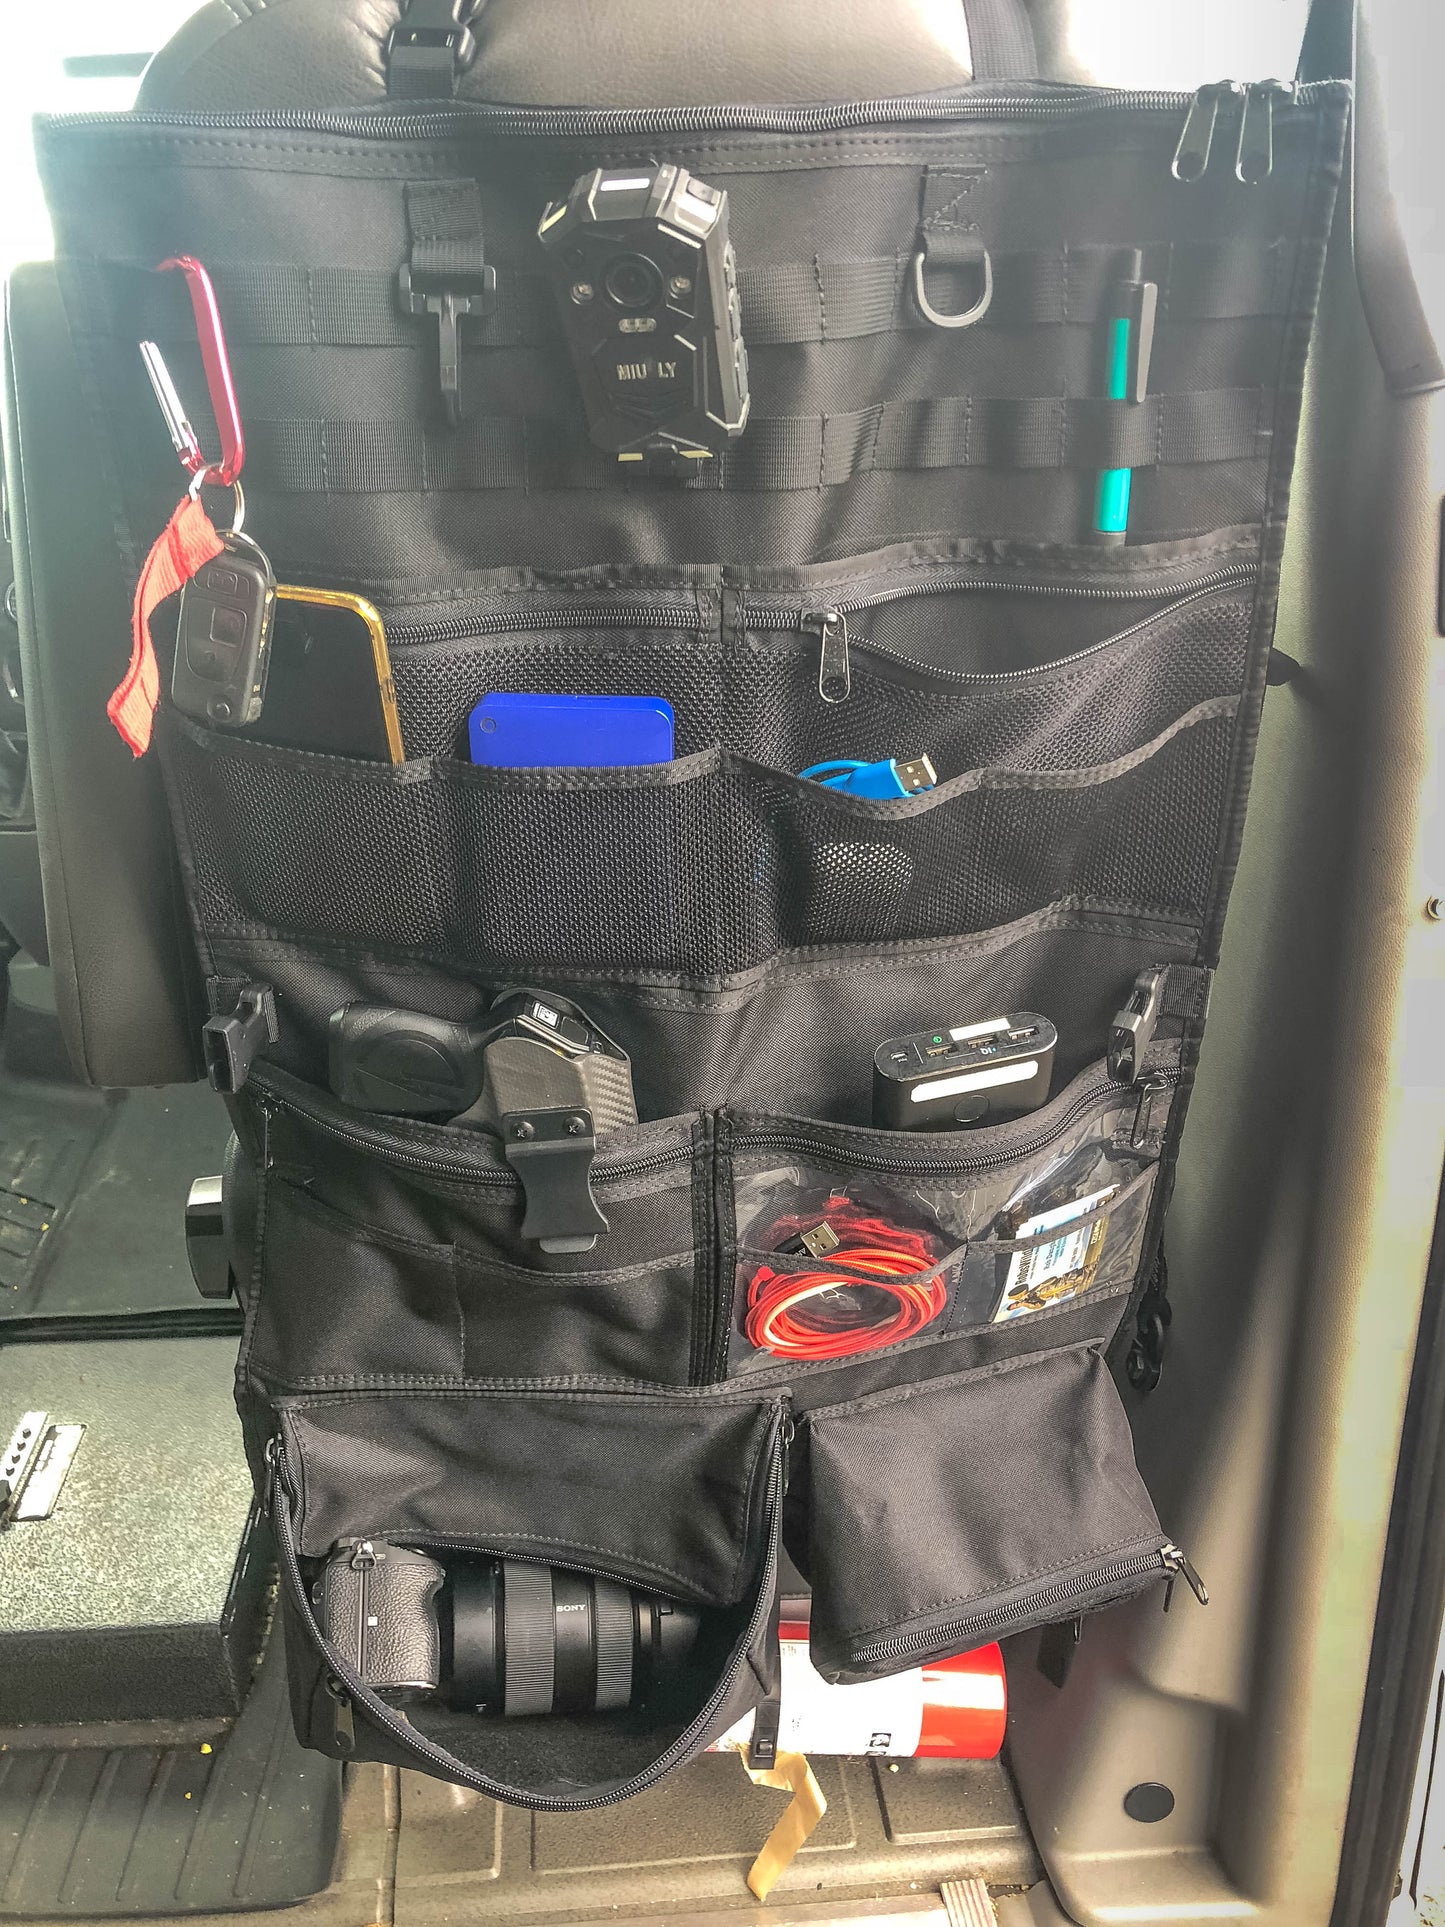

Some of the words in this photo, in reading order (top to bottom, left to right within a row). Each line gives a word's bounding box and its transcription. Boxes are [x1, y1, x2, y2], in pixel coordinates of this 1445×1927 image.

[617, 363, 647, 380] MIU
[658, 361, 676, 378] LY
[556, 1604, 586, 1612] SONY
